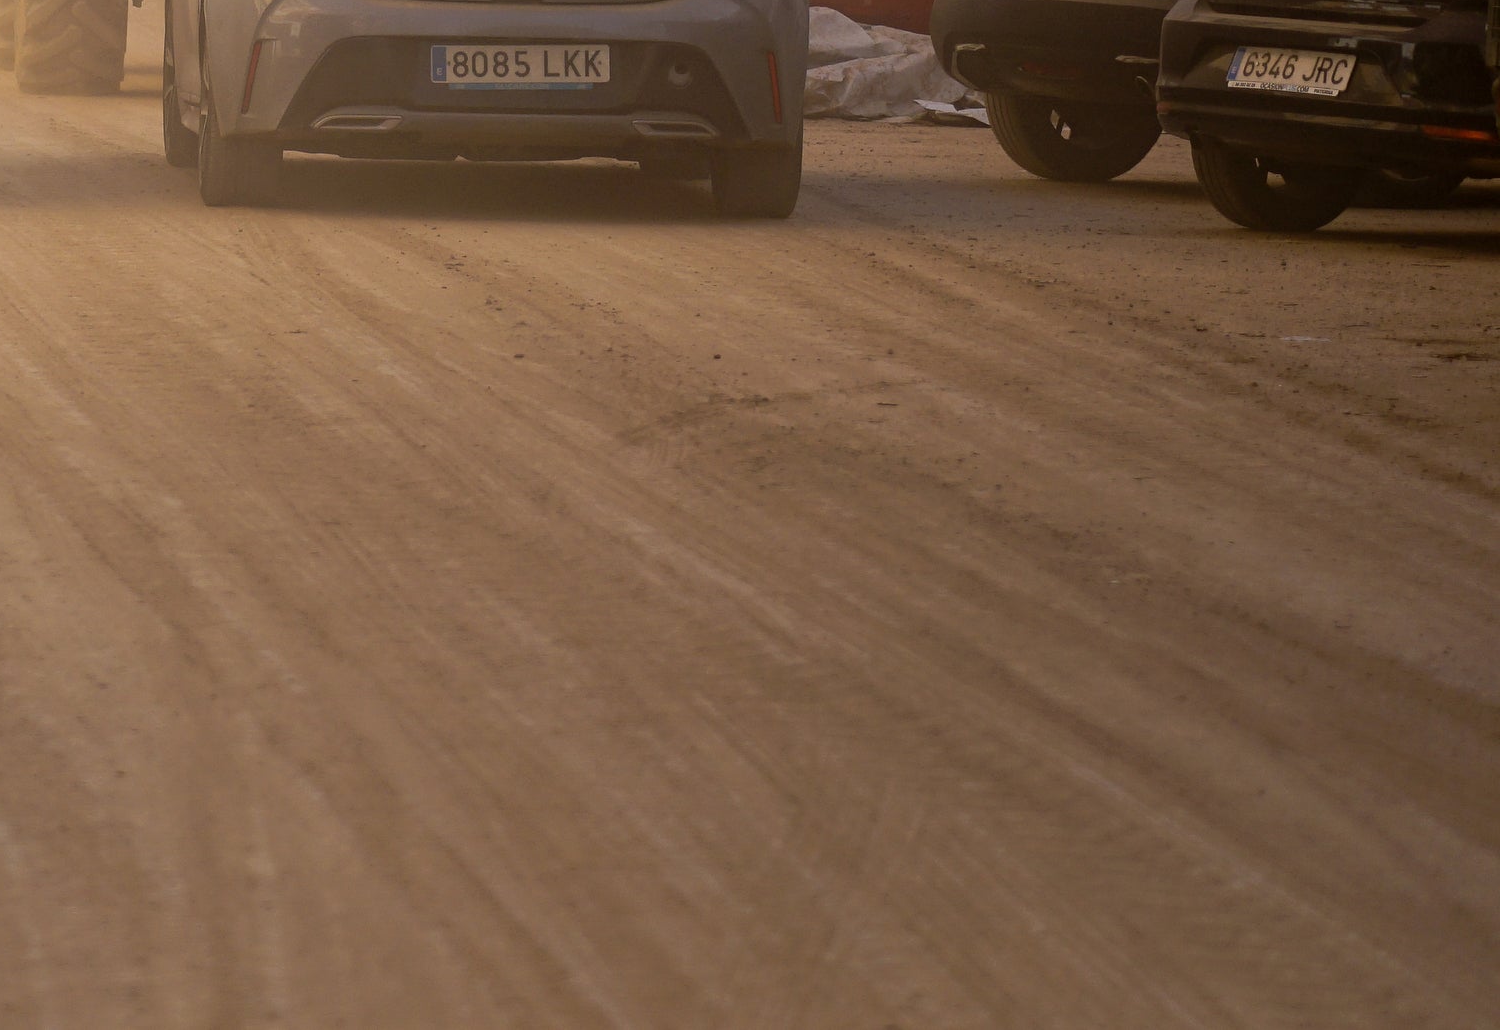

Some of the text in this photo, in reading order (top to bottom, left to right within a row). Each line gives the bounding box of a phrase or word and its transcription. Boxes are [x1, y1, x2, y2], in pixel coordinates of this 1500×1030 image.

[452, 50, 531, 78] 8085
[543, 49, 601, 78] LKK
[1242, 51, 1349, 85] 6346 JRC
